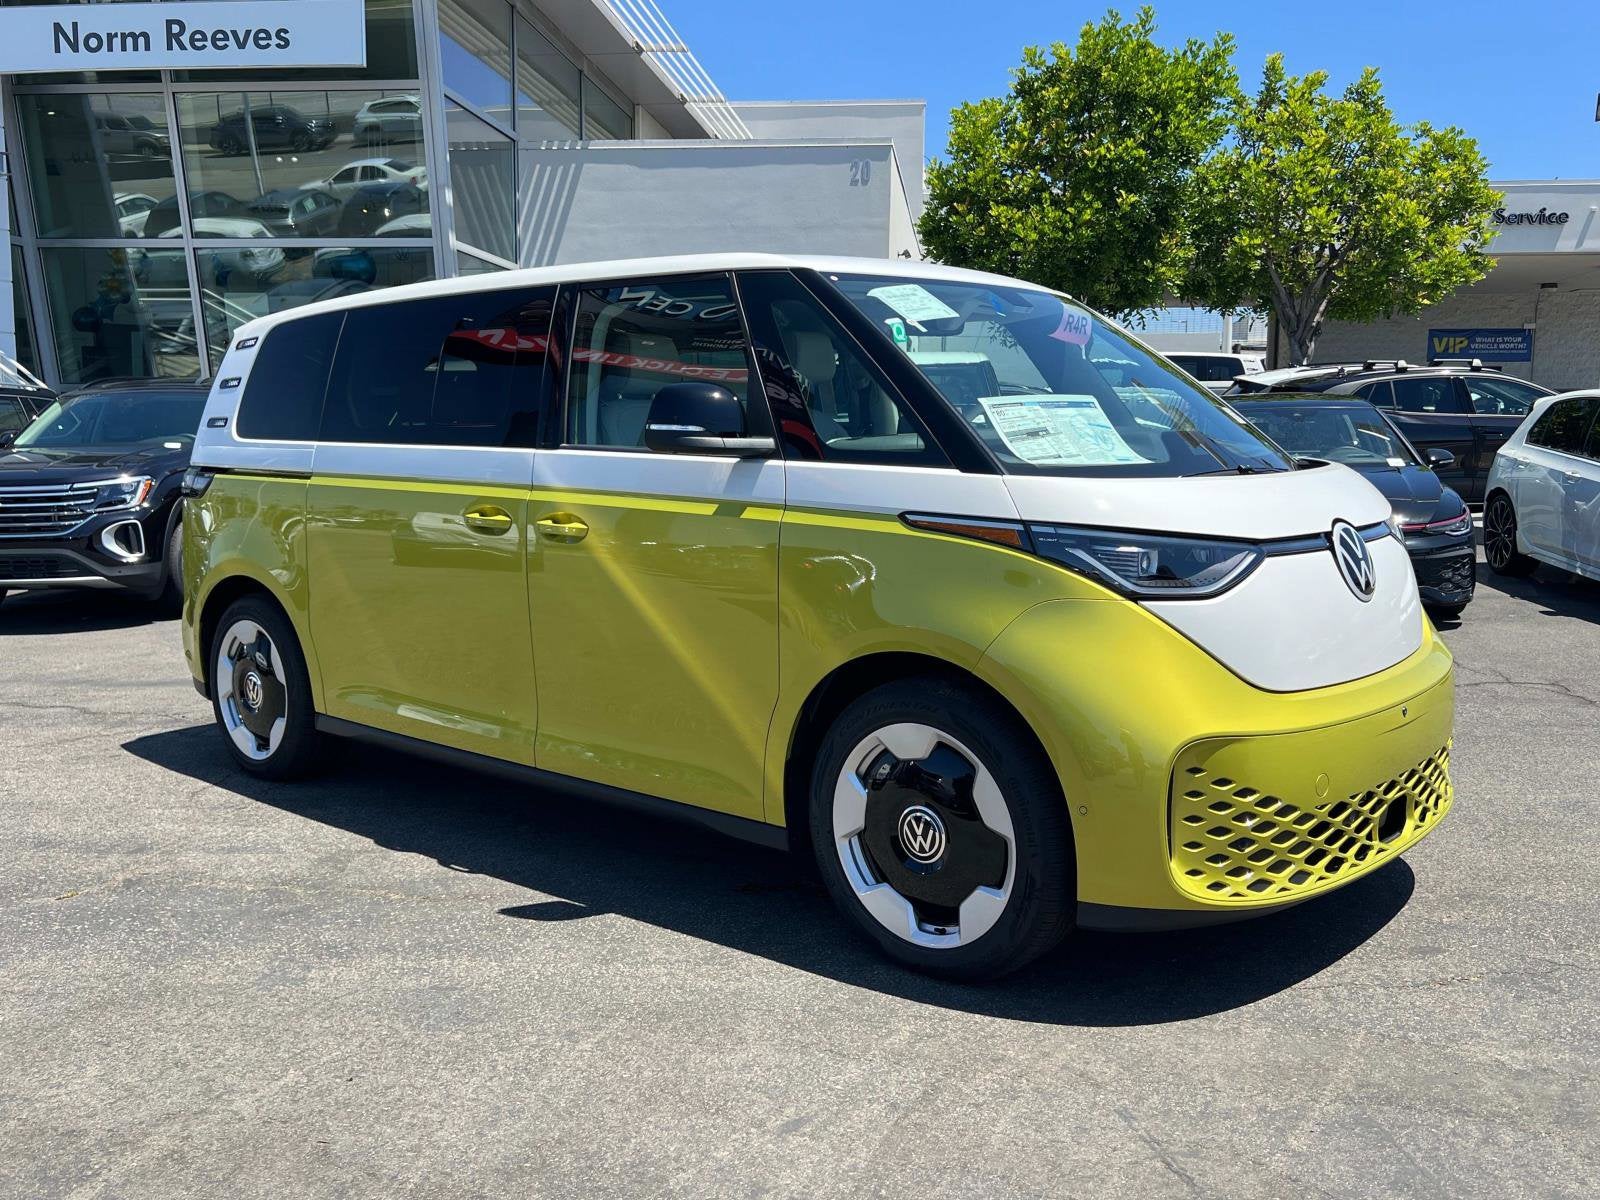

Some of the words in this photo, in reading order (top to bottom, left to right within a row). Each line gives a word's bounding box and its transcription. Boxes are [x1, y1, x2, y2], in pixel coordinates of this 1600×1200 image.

[53, 21, 151, 53] Norm
[165, 19, 291, 51] Reeves
[849, 160, 871, 187] 20
[1492, 207, 1569, 225] Service
[1063, 314, 1088, 336] R4R
[1432, 336, 1469, 353] VIP
[1503, 335, 1522, 343] YOUR
[1335, 522, 1375, 599] VW
[903, 812, 940, 857] VW
